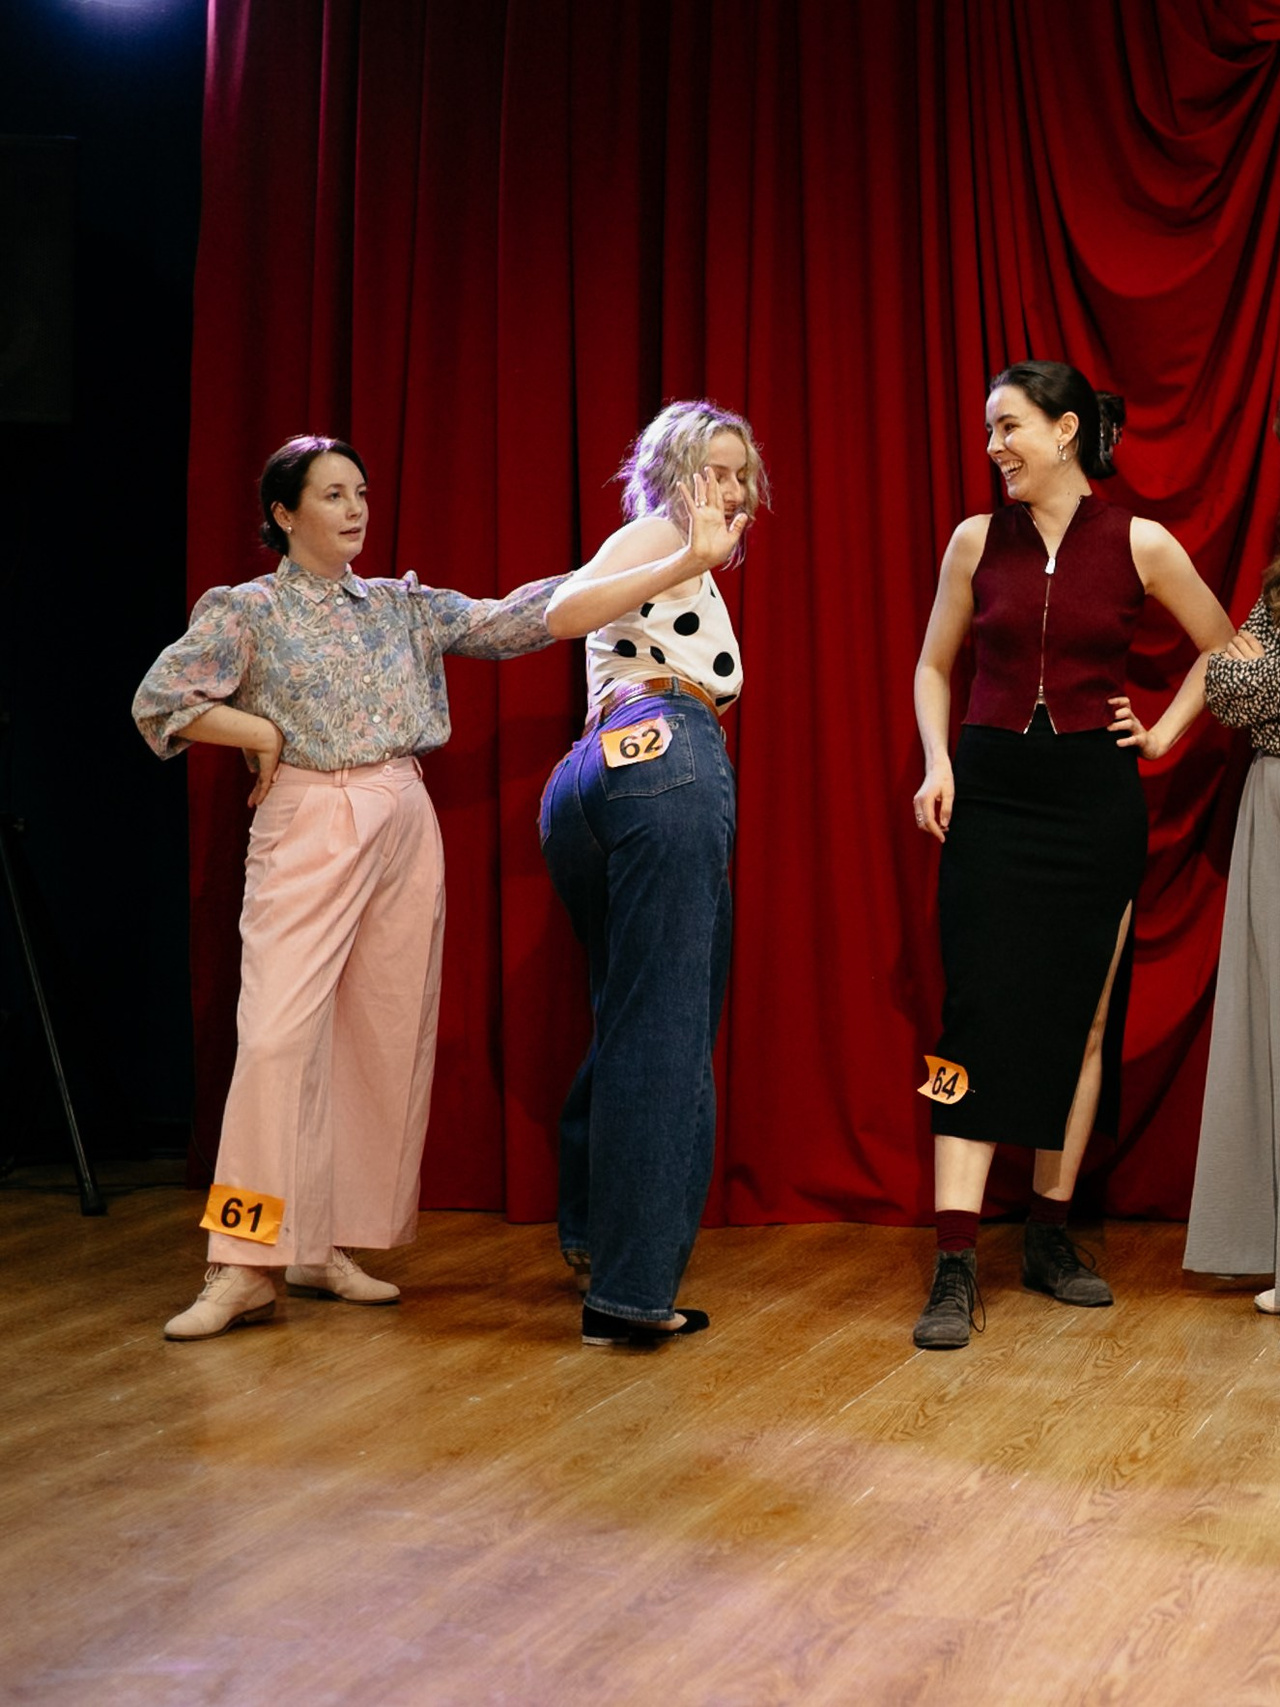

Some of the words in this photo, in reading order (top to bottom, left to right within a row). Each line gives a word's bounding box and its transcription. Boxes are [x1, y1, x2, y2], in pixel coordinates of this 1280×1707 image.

[619, 728, 663, 759] 62
[932, 1066, 960, 1100] 64
[221, 1197, 263, 1233] 61
